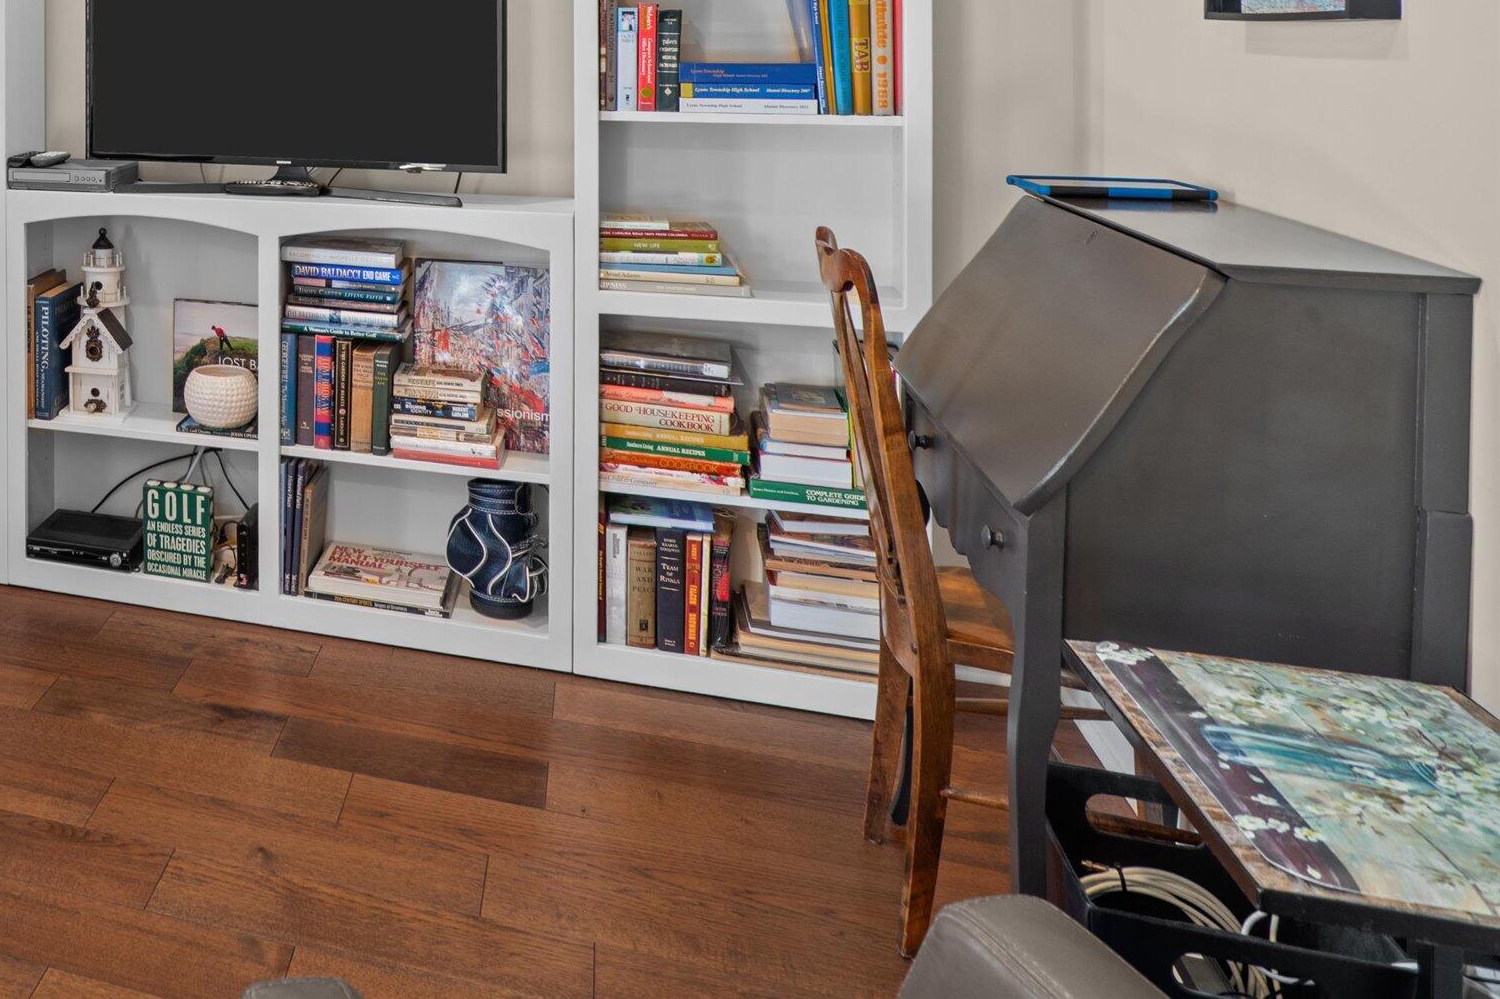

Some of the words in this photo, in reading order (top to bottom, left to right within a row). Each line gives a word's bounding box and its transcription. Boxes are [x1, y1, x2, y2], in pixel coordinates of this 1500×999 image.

[646, 5, 654, 31] Webster's
[854, 37, 870, 72] TAB
[709, 87, 731, 95] Township
[295, 265, 320, 277] DAVID
[320, 267, 361, 280] BALDACCI
[362, 270, 374, 280] END
[374, 271, 391, 281] GAME
[344, 291, 364, 299] LIVING
[40, 305, 49, 372] PILOTING,
[281, 370, 289, 383] WILL
[604, 402, 634, 414] GOOD
[638, 406, 715, 424] HOUSEKEEPING
[658, 418, 714, 433] COOKBOOK
[656, 433, 680, 442] ANNUAL
[626, 440, 643, 449] Southern
[656, 443, 681, 453] ANNUAL
[681, 446, 706, 456] RECIPES
[658, 459, 719, 474] COOKBOOK
[805, 489, 842, 499] COMPLETE
[843, 493, 867, 502] GUIDE
[806, 495, 817, 503] TO
[817, 497, 859, 507] GARDENING
[147, 489, 205, 525] GOLF
[147, 520, 156, 531] AN
[156, 521, 183, 535] ENDLESS
[184, 525, 206, 538] SERIES
[147, 532, 157, 548] OF
[159, 534, 206, 555] TRAGEDIES
[333, 545, 366, 555] NEW
[147, 548, 182, 565] OBSCURED
[183, 554, 193, 566] BY
[194, 556, 206, 569] THE
[328, 556, 385, 570] MANUAL
[147, 561, 182, 577] OCCASIONAL
[182, 567, 206, 581] MIRACLE
[635, 565, 653, 574] WAR
[660, 562, 679, 572] TEAM
[659, 575, 681, 585] RIVALS
